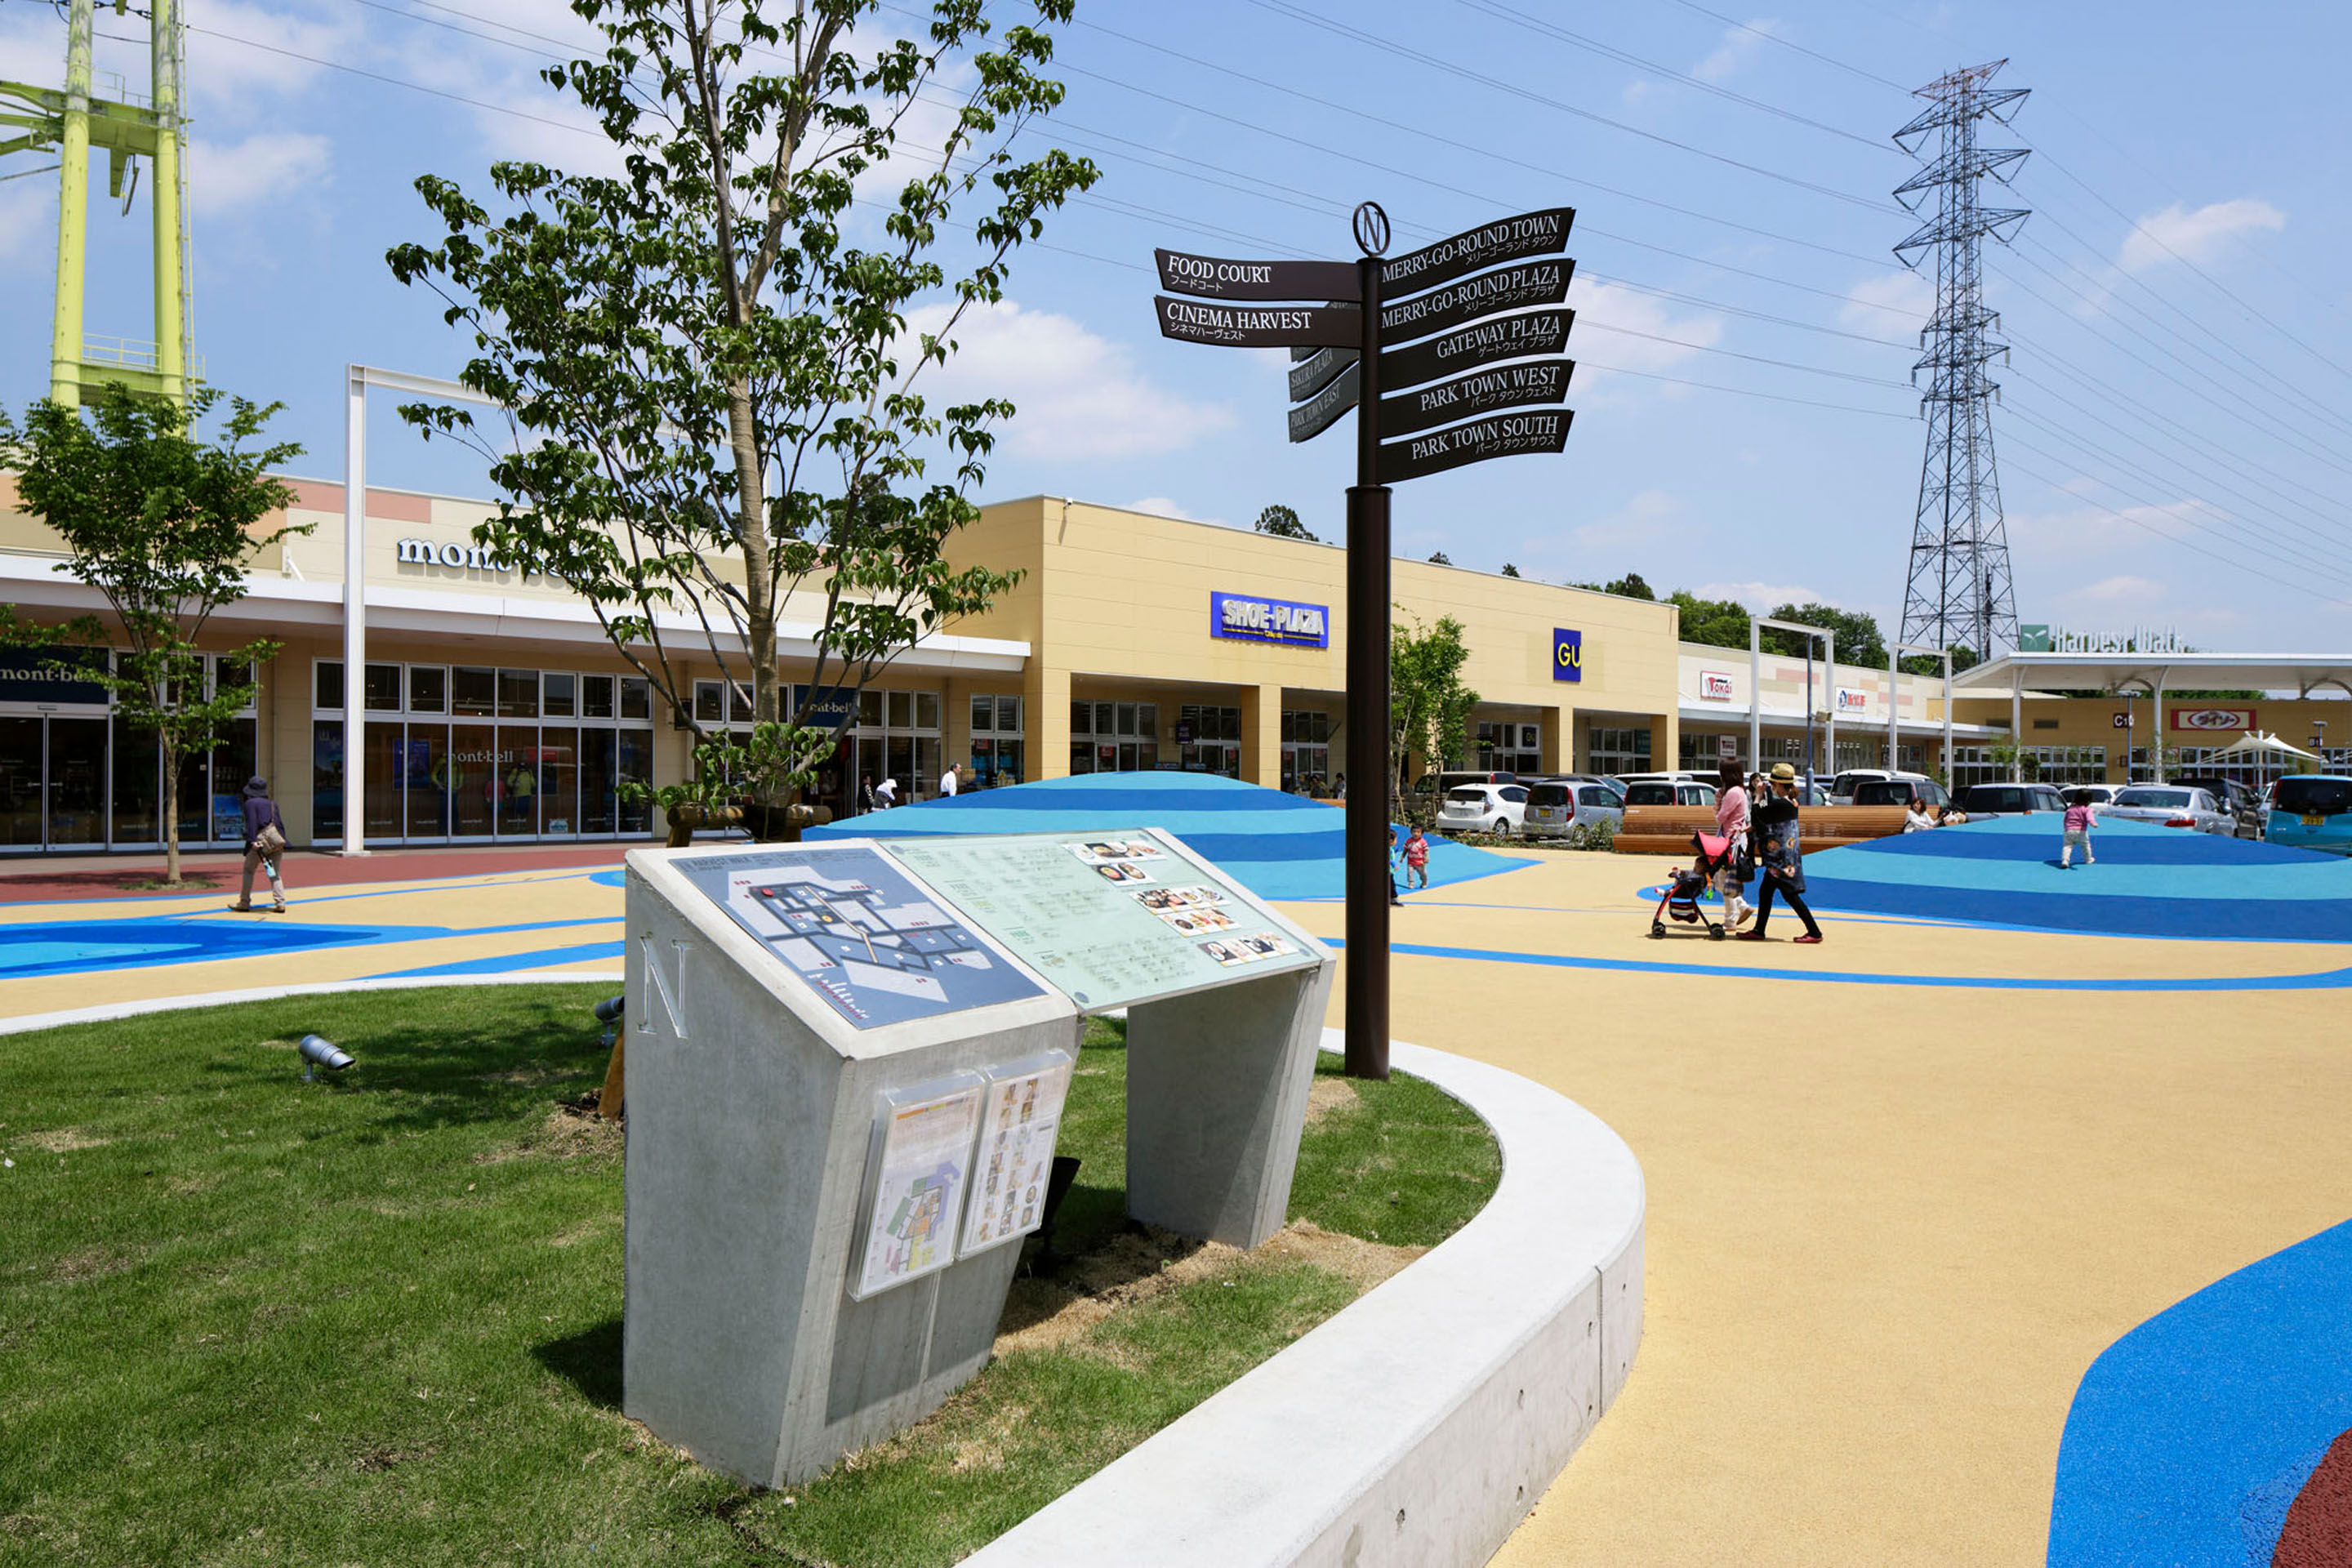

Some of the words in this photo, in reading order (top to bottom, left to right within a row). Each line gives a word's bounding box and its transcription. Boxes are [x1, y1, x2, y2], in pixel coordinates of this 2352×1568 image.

[1382, 225, 1510, 283] MERRY-GO-ROUND
[1511, 214, 1561, 239] TOWN
[1465, 240, 1530, 266] メリーゴーランド
[1532, 234, 1557, 247] タウン
[1167, 255, 1214, 279] FOOD
[1218, 264, 1272, 283] COURT
[1170, 274, 1223, 292] フードコート
[1382, 274, 1510, 328] MERRY-GO-ROUND
[1511, 265, 1561, 290] PLAZA
[1464, 289, 1529, 314] メリーゴーランド
[1530, 284, 1557, 298] プラザ
[1166, 302, 1233, 327] CINEMA
[1236, 312, 1312, 330] HARVEST
[1170, 322, 1246, 341] シネマハーヴェスト
[1437, 323, 1508, 359] GATEWAY
[1511, 315, 1561, 339] PLAZA
[1478, 340, 1525, 359] ゲートウェイ
[1529, 334, 1557, 347] プラザ
[1313, 348, 1333, 378] PLAZA
[1420, 385, 1459, 412] PARK
[1461, 372, 1508, 397] TOWN
[1512, 366, 1561, 386] WEST
[1471, 394, 1497, 408] パーク
[1290, 409, 1306, 429] PARK
[1325, 382, 1341, 410] EAST
[1411, 434, 1451, 461] PARK
[1452, 421, 1499, 448] TOWN
[1502, 416, 1560, 438] SOUTH
[1475, 439, 1502, 455] パーク
[2053, 623, 2130, 653] Harvest
[2134, 623, 2185, 653] Walk
[1557, 642, 1581, 667] GU
[2198, 714, 2236, 726] ダイソー
